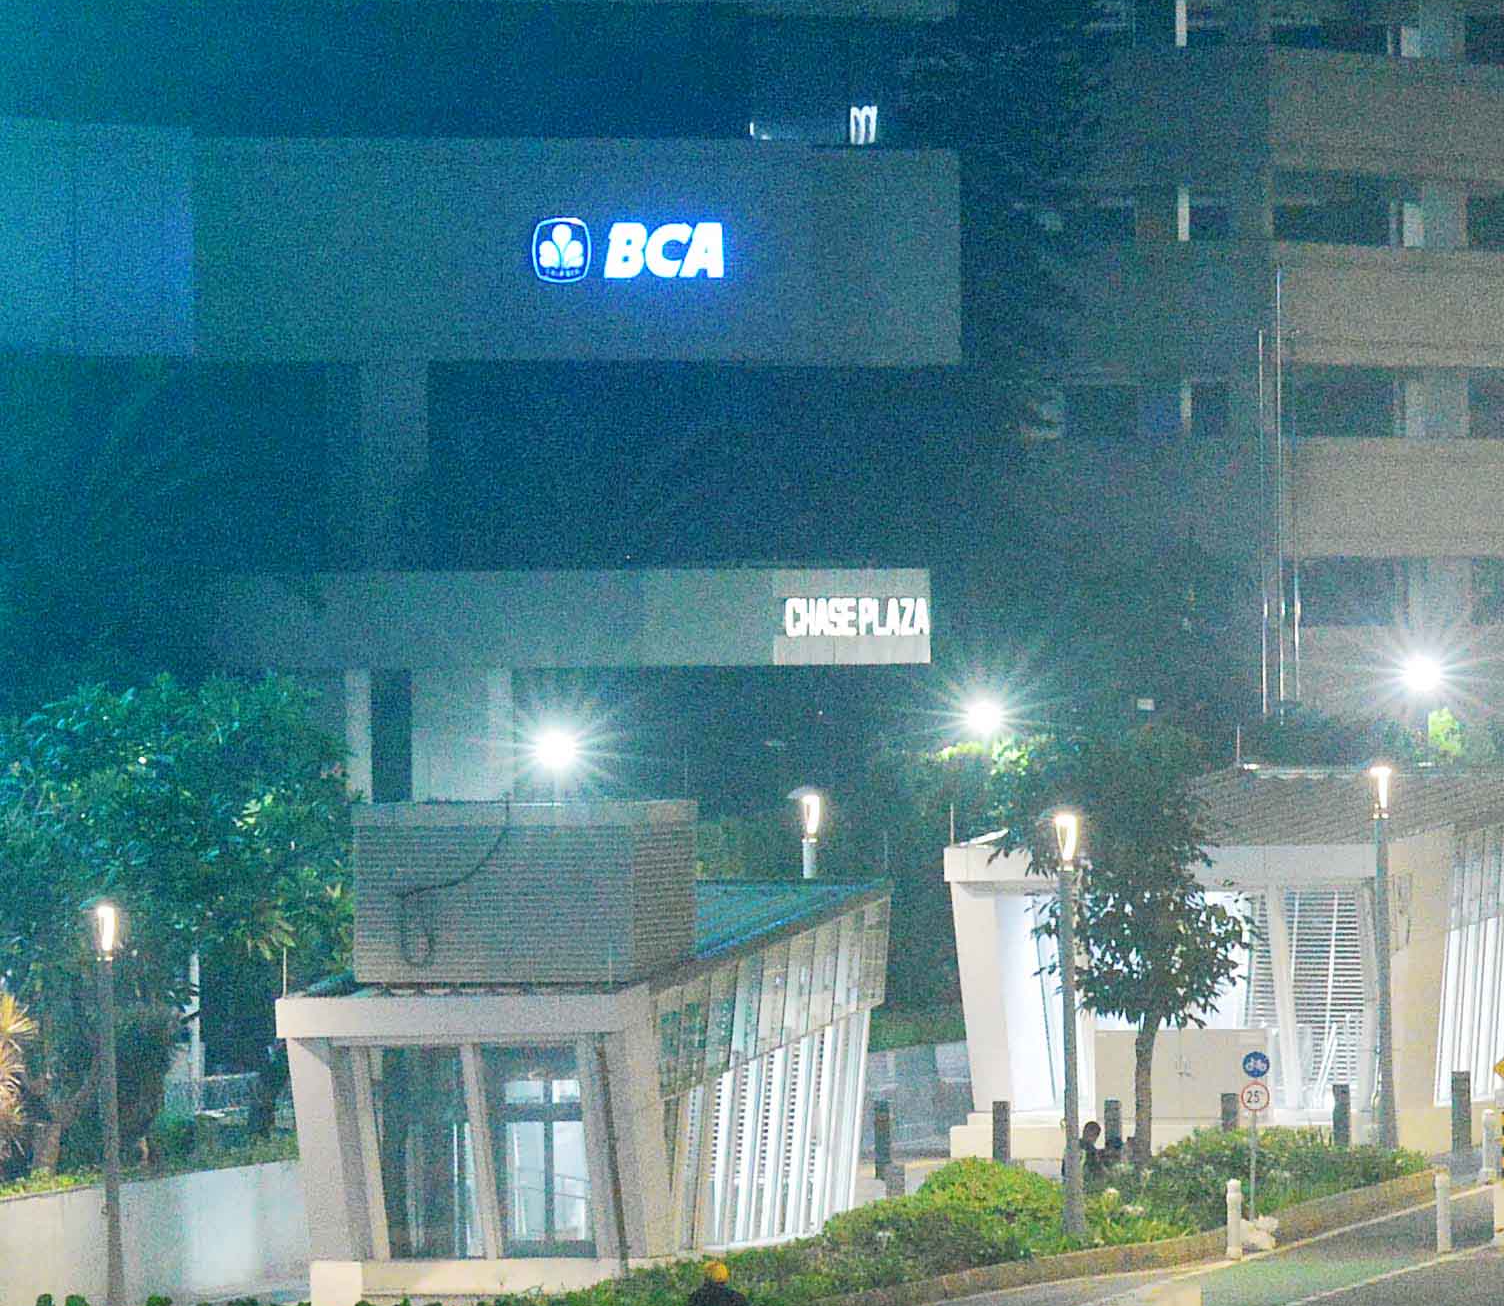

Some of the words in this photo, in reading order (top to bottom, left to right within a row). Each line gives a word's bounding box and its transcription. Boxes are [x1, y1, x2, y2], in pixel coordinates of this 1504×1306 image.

[604, 221, 725, 279] BCA
[785, 596, 857, 637] CHASE
[858, 596, 930, 636] PLAZA
